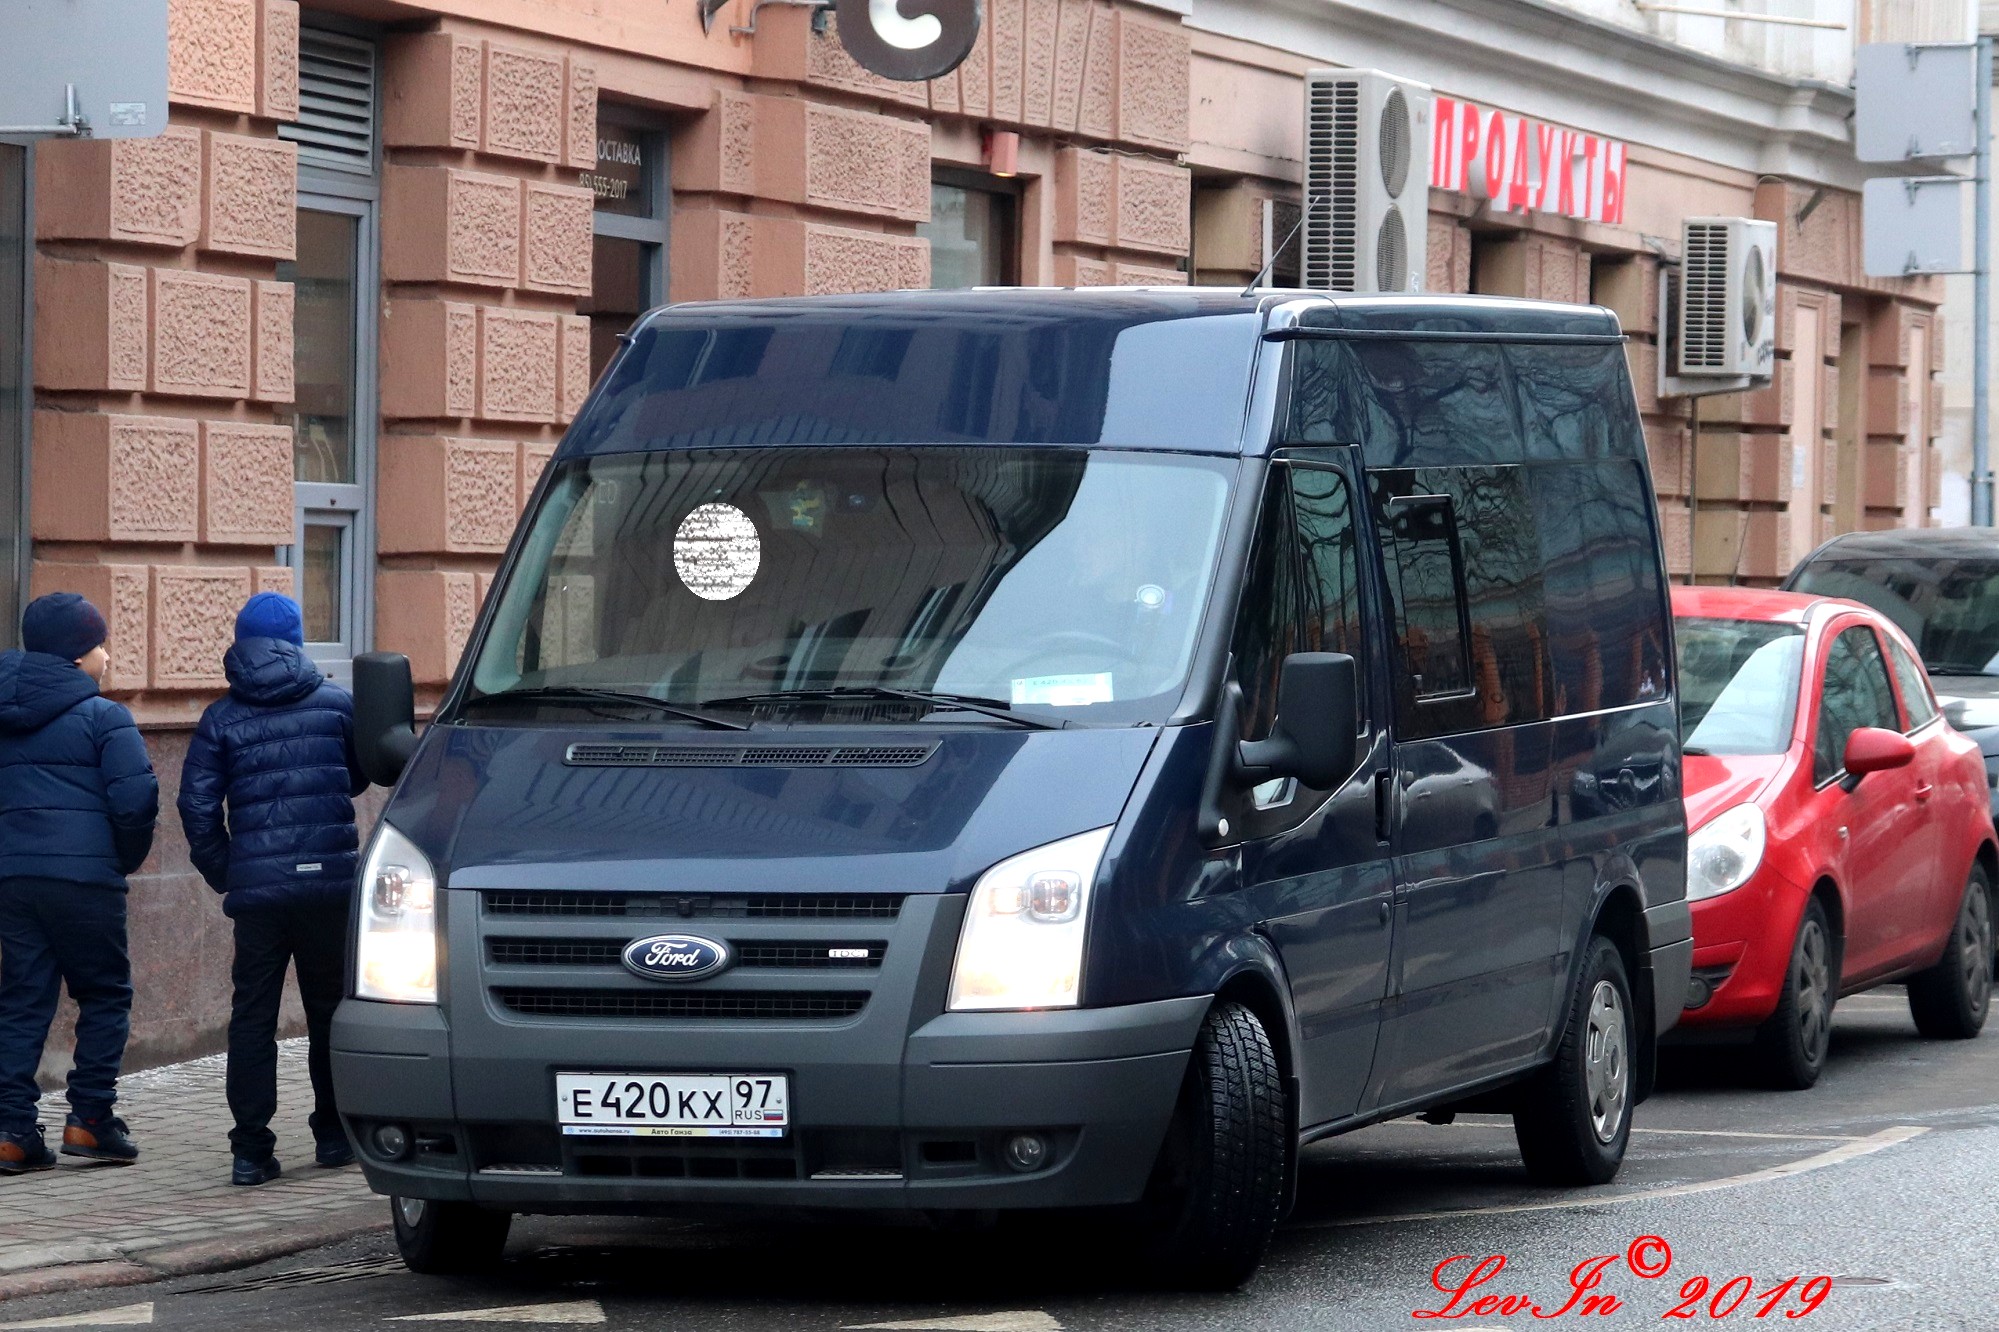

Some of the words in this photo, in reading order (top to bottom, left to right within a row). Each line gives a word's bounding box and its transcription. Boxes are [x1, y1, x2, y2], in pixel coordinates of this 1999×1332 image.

[597, 139, 641, 166] ОСТАВКА
[1432, 97, 1628, 225] ПРОДУКТЫ
[645, 941, 701, 967] Ford
[735, 1080, 772, 1109] 97
[735, 1110, 763, 1120] RUS
[651, 1128, 669, 1136] Авто
